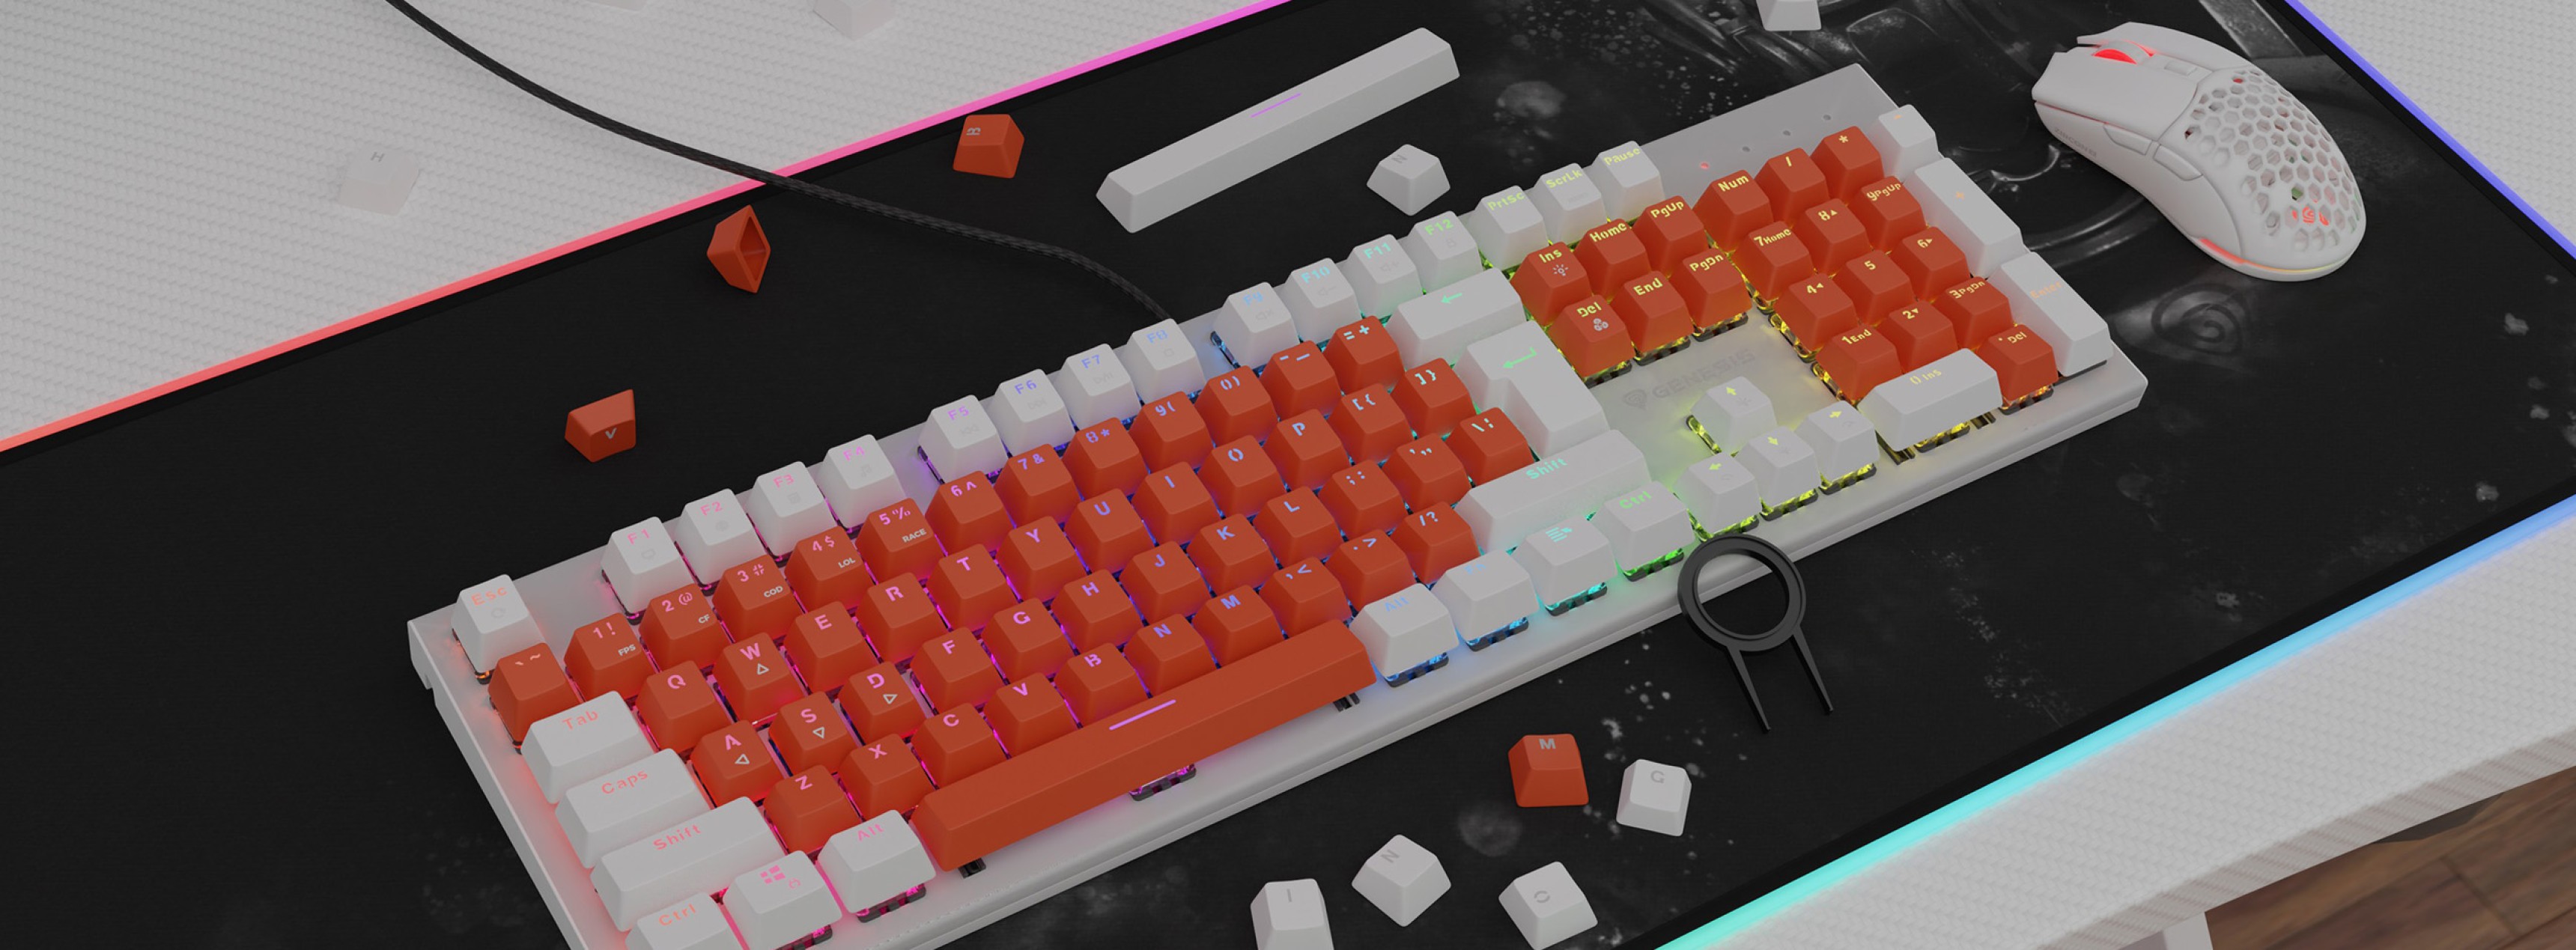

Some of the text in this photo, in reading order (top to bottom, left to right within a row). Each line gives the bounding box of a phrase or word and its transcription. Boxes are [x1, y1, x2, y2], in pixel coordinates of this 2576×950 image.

[370, 151, 386, 162] H
[1603, 147, 1641, 165] Pause
[1546, 169, 1583, 189] ScrLk
[1718, 175, 1749, 192] Num
[1650, 201, 1684, 218] PgUp
[1424, 219, 1453, 235] F12
[1590, 222, 1627, 242] Home
[1364, 242, 1391, 259] F11
[1539, 249, 1562, 263] Ins
[1689, 254, 1724, 272] PgDn
[1864, 260, 1876, 270] 5
[1301, 266, 1330, 284] F10
[1634, 278, 1663, 296] End
[1577, 302, 1602, 317] Del
[2008, 331, 2027, 344] Del
[1081, 354, 1101, 369] F7
[1651, 348, 1755, 398] GENESIS
[1014, 380, 1036, 395] F6
[948, 406, 969, 420] F5
[605, 427, 617, 439] V
[1292, 422, 1305, 436] P
[1526, 457, 1567, 479] Shift
[773, 474, 794, 487] F3
[1164, 475, 1175, 488] I
[1284, 501, 1300, 512] L
[1618, 491, 1652, 509] Ctrl
[699, 501, 723, 516] F2
[1094, 501, 1111, 515] U
[627, 529, 649, 544] F1
[902, 529, 927, 543] RACE
[1025, 529, 1040, 543] Y
[1217, 526, 1235, 540] K
[838, 557, 856, 568] LOL
[957, 556, 971, 570] T
[1155, 554, 1165, 567] J
[471, 587, 507, 606] Esc
[763, 586, 783, 597] COD
[885, 586, 904, 601] R
[1081, 582, 1099, 596] H
[1221, 594, 1241, 609] M
[1383, 595, 1409, 612] Alt
[698, 614, 710, 624] CF
[815, 615, 832, 630] E
[1013, 611, 1031, 624] G
[1153, 624, 1172, 638] N
[618, 644, 636, 657] FPS
[740, 643, 761, 660] W
[942, 640, 956, 654] F
[1084, 654, 1102, 667] B
[667, 675, 686, 689] Q
[867, 673, 884, 688] D
[1012, 683, 1028, 696] V
[562, 709, 598, 731] Tab
[801, 708, 817, 723] S
[943, 714, 959, 727] C
[725, 734, 741, 750] A
[1539, 738, 1556, 749] M
[869, 744, 887, 759] X
[601, 770, 648, 794] Caps
[795, 775, 812, 791] Z
[1650, 770, 1665, 784] G
[653, 824, 701, 850] Shift
[857, 823, 884, 842] Alt
[1381, 849, 1400, 863] N
[658, 903, 696, 926] Ctrl
